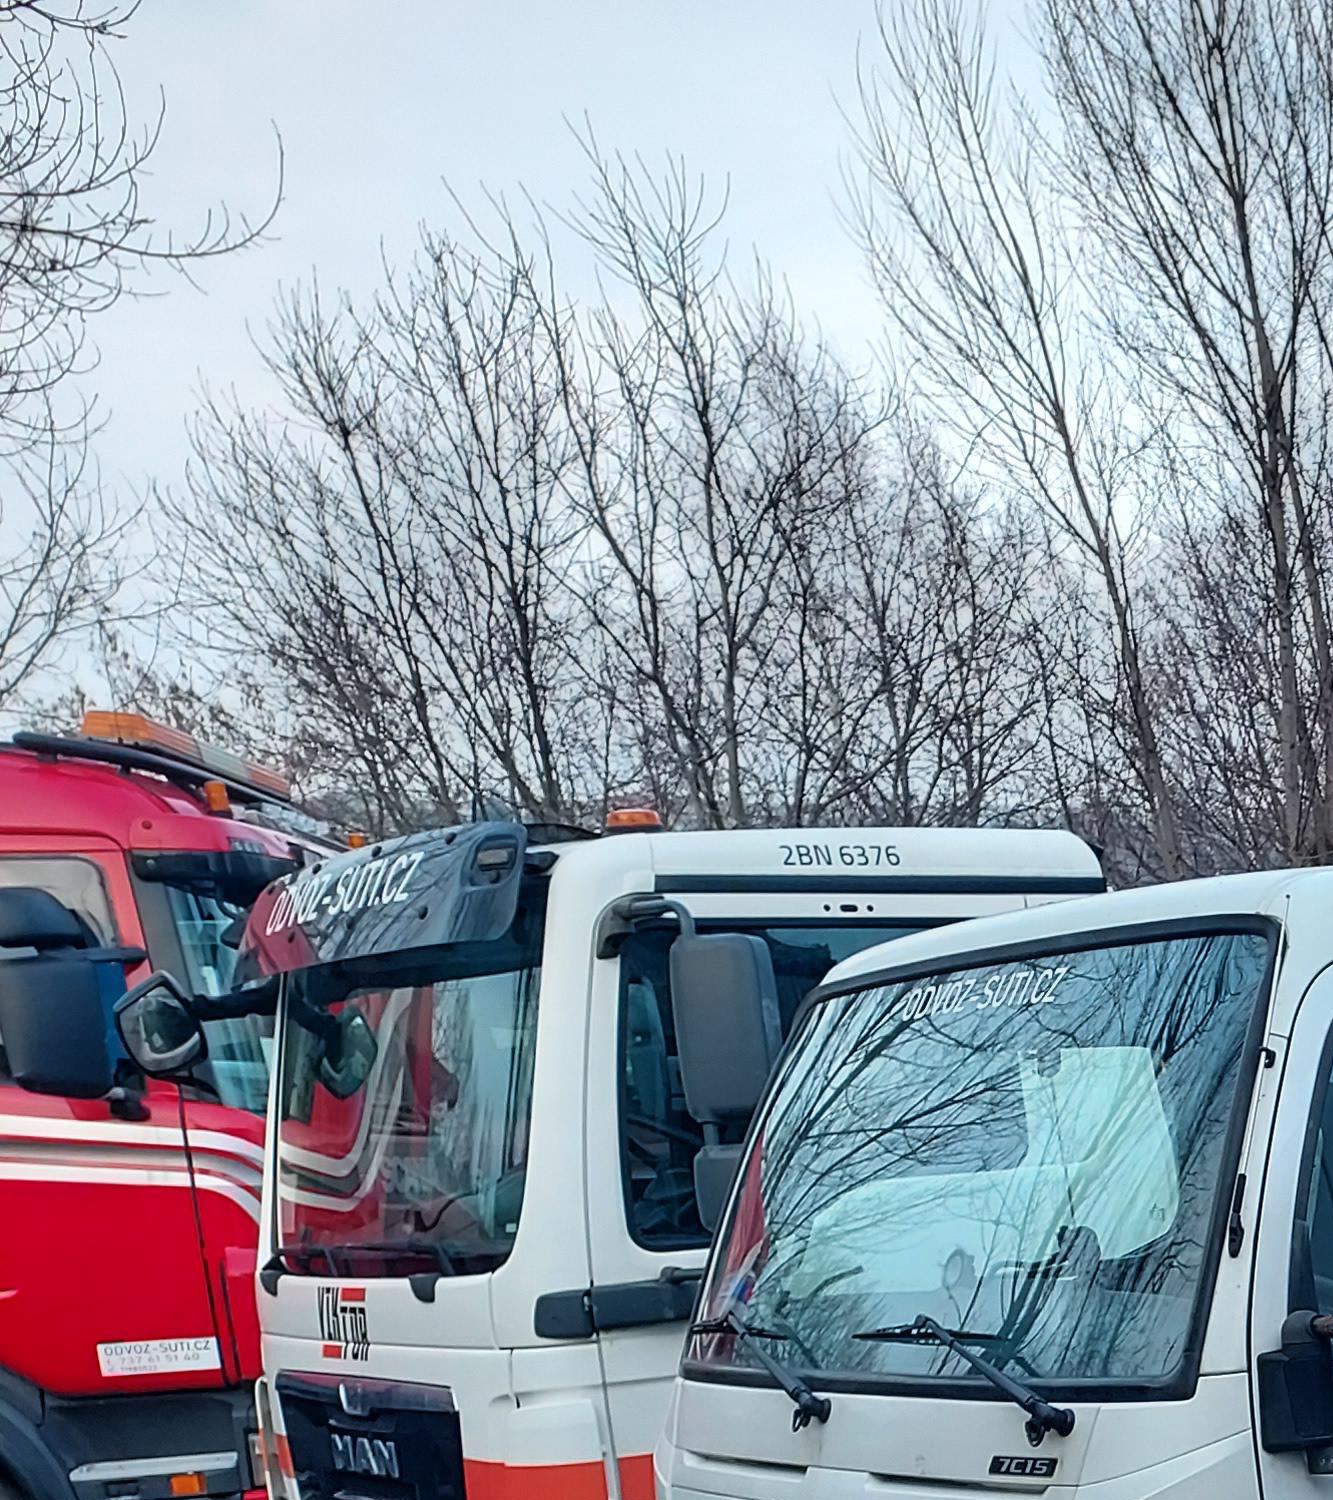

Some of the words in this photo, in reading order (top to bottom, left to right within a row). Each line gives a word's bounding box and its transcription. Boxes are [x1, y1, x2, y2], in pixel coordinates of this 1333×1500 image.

[779, 844, 833, 867] 2BN
[838, 844, 900, 867] 6376
[264, 851, 425, 937] ODVOZ-SUTI.CZ
[903, 967, 1069, 1022] ODVOZ-SUTI.CZ
[103, 1340, 211, 1357] ODVOZ-SUTI.CZ
[331, 1433, 400, 1479] MAN
[999, 1458, 1050, 1475] 7C15
